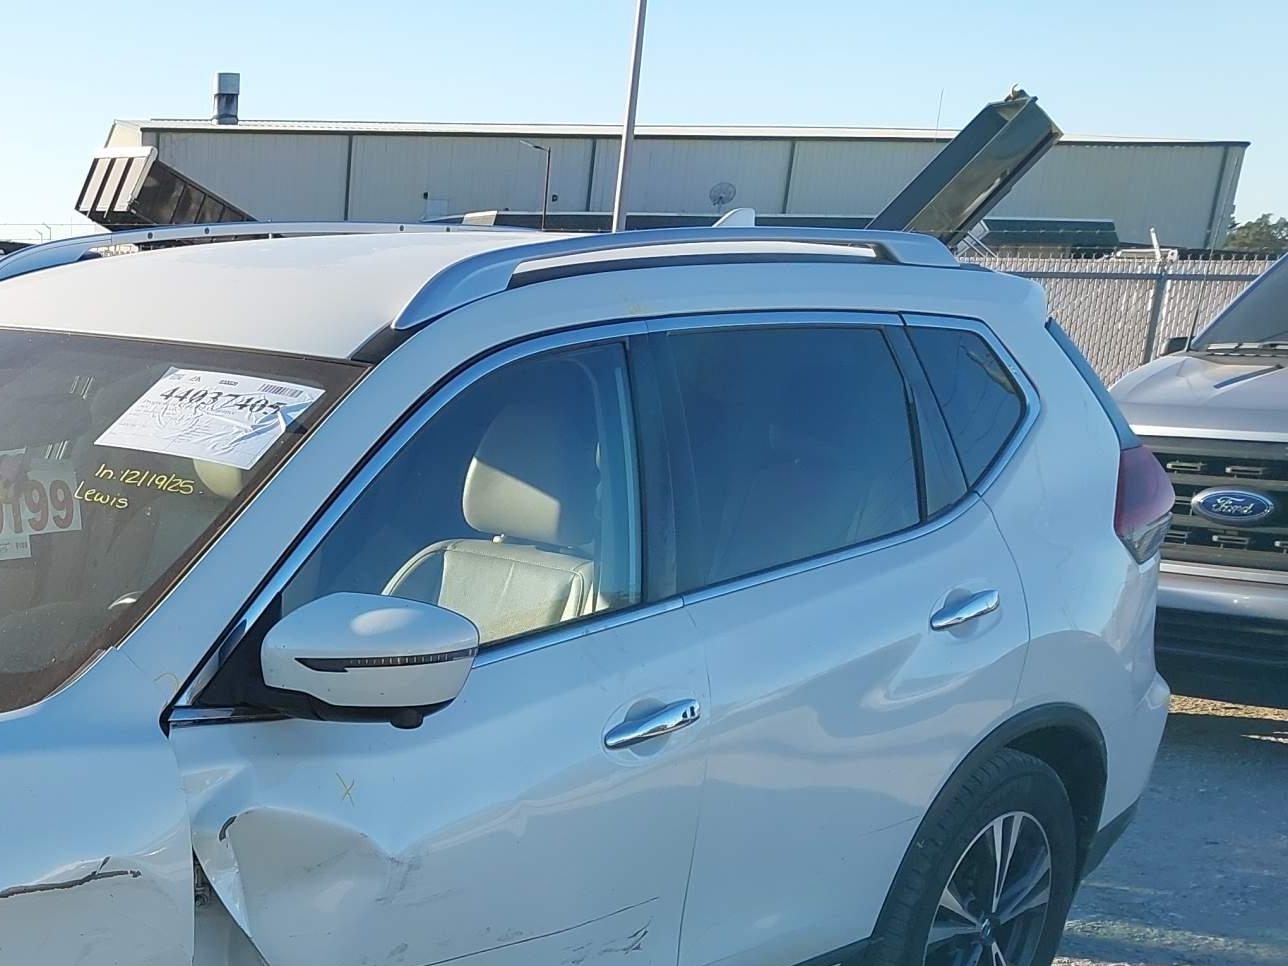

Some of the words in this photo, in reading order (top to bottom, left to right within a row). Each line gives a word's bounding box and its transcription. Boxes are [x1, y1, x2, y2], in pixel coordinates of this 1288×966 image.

[159, 386, 287, 415] 44037405
[74, 480, 129, 509] Lewis
[120, 469, 194, 495] 12/19/25
[1212, 496, 1255, 514] Ford
